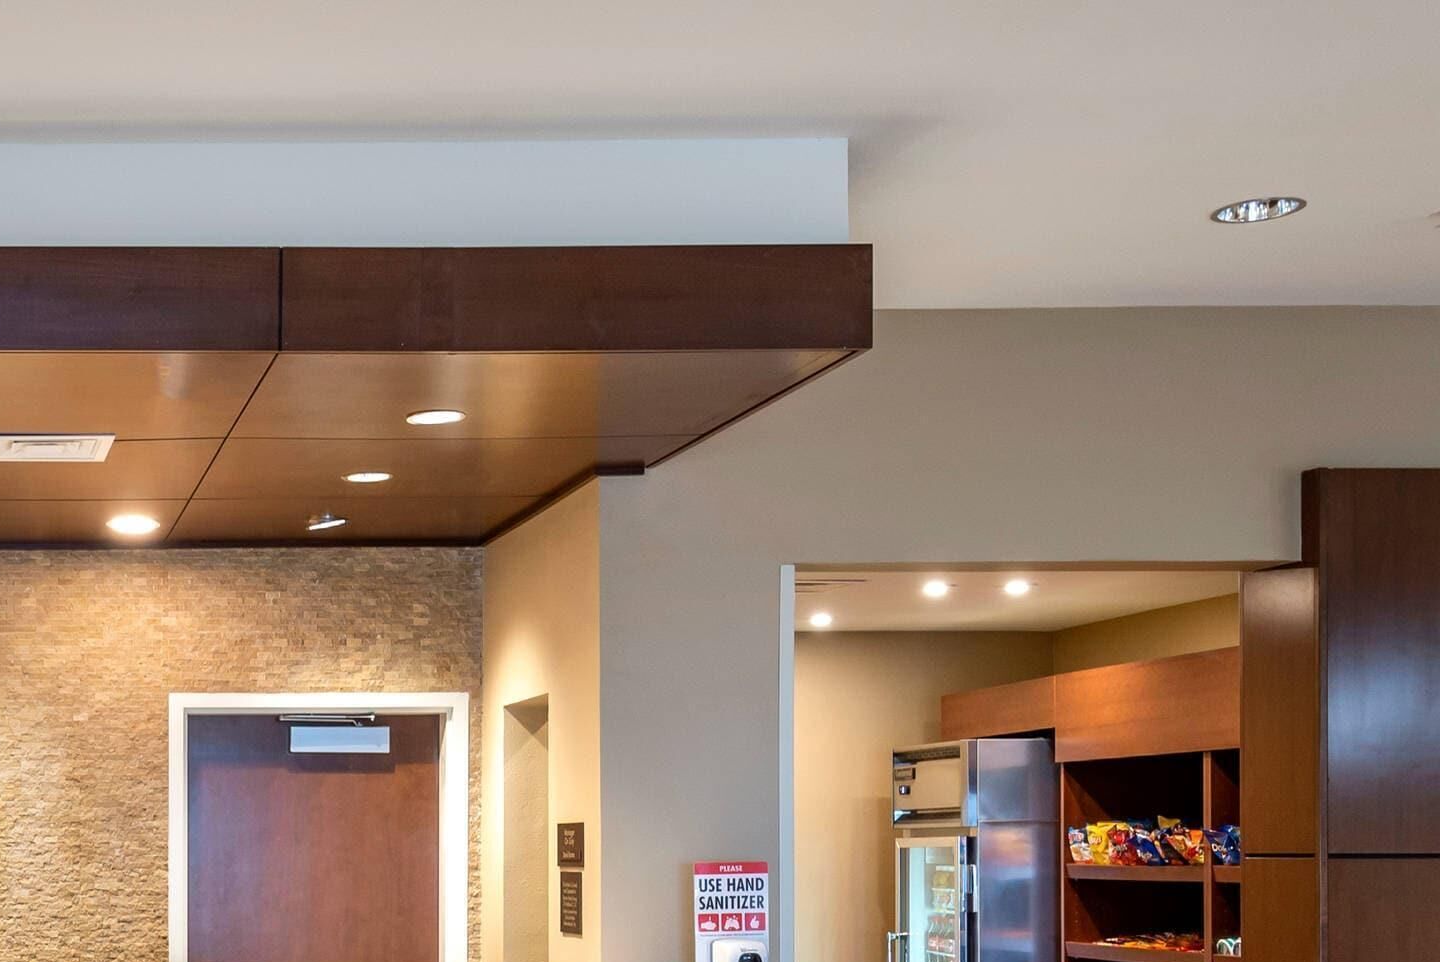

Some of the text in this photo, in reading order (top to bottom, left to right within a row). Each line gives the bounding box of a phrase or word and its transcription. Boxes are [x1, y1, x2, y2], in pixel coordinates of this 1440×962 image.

[719, 865, 743, 873] PLEASE
[698, 877, 764, 892] USE HAND
[699, 895, 765, 911] SANITIZER
